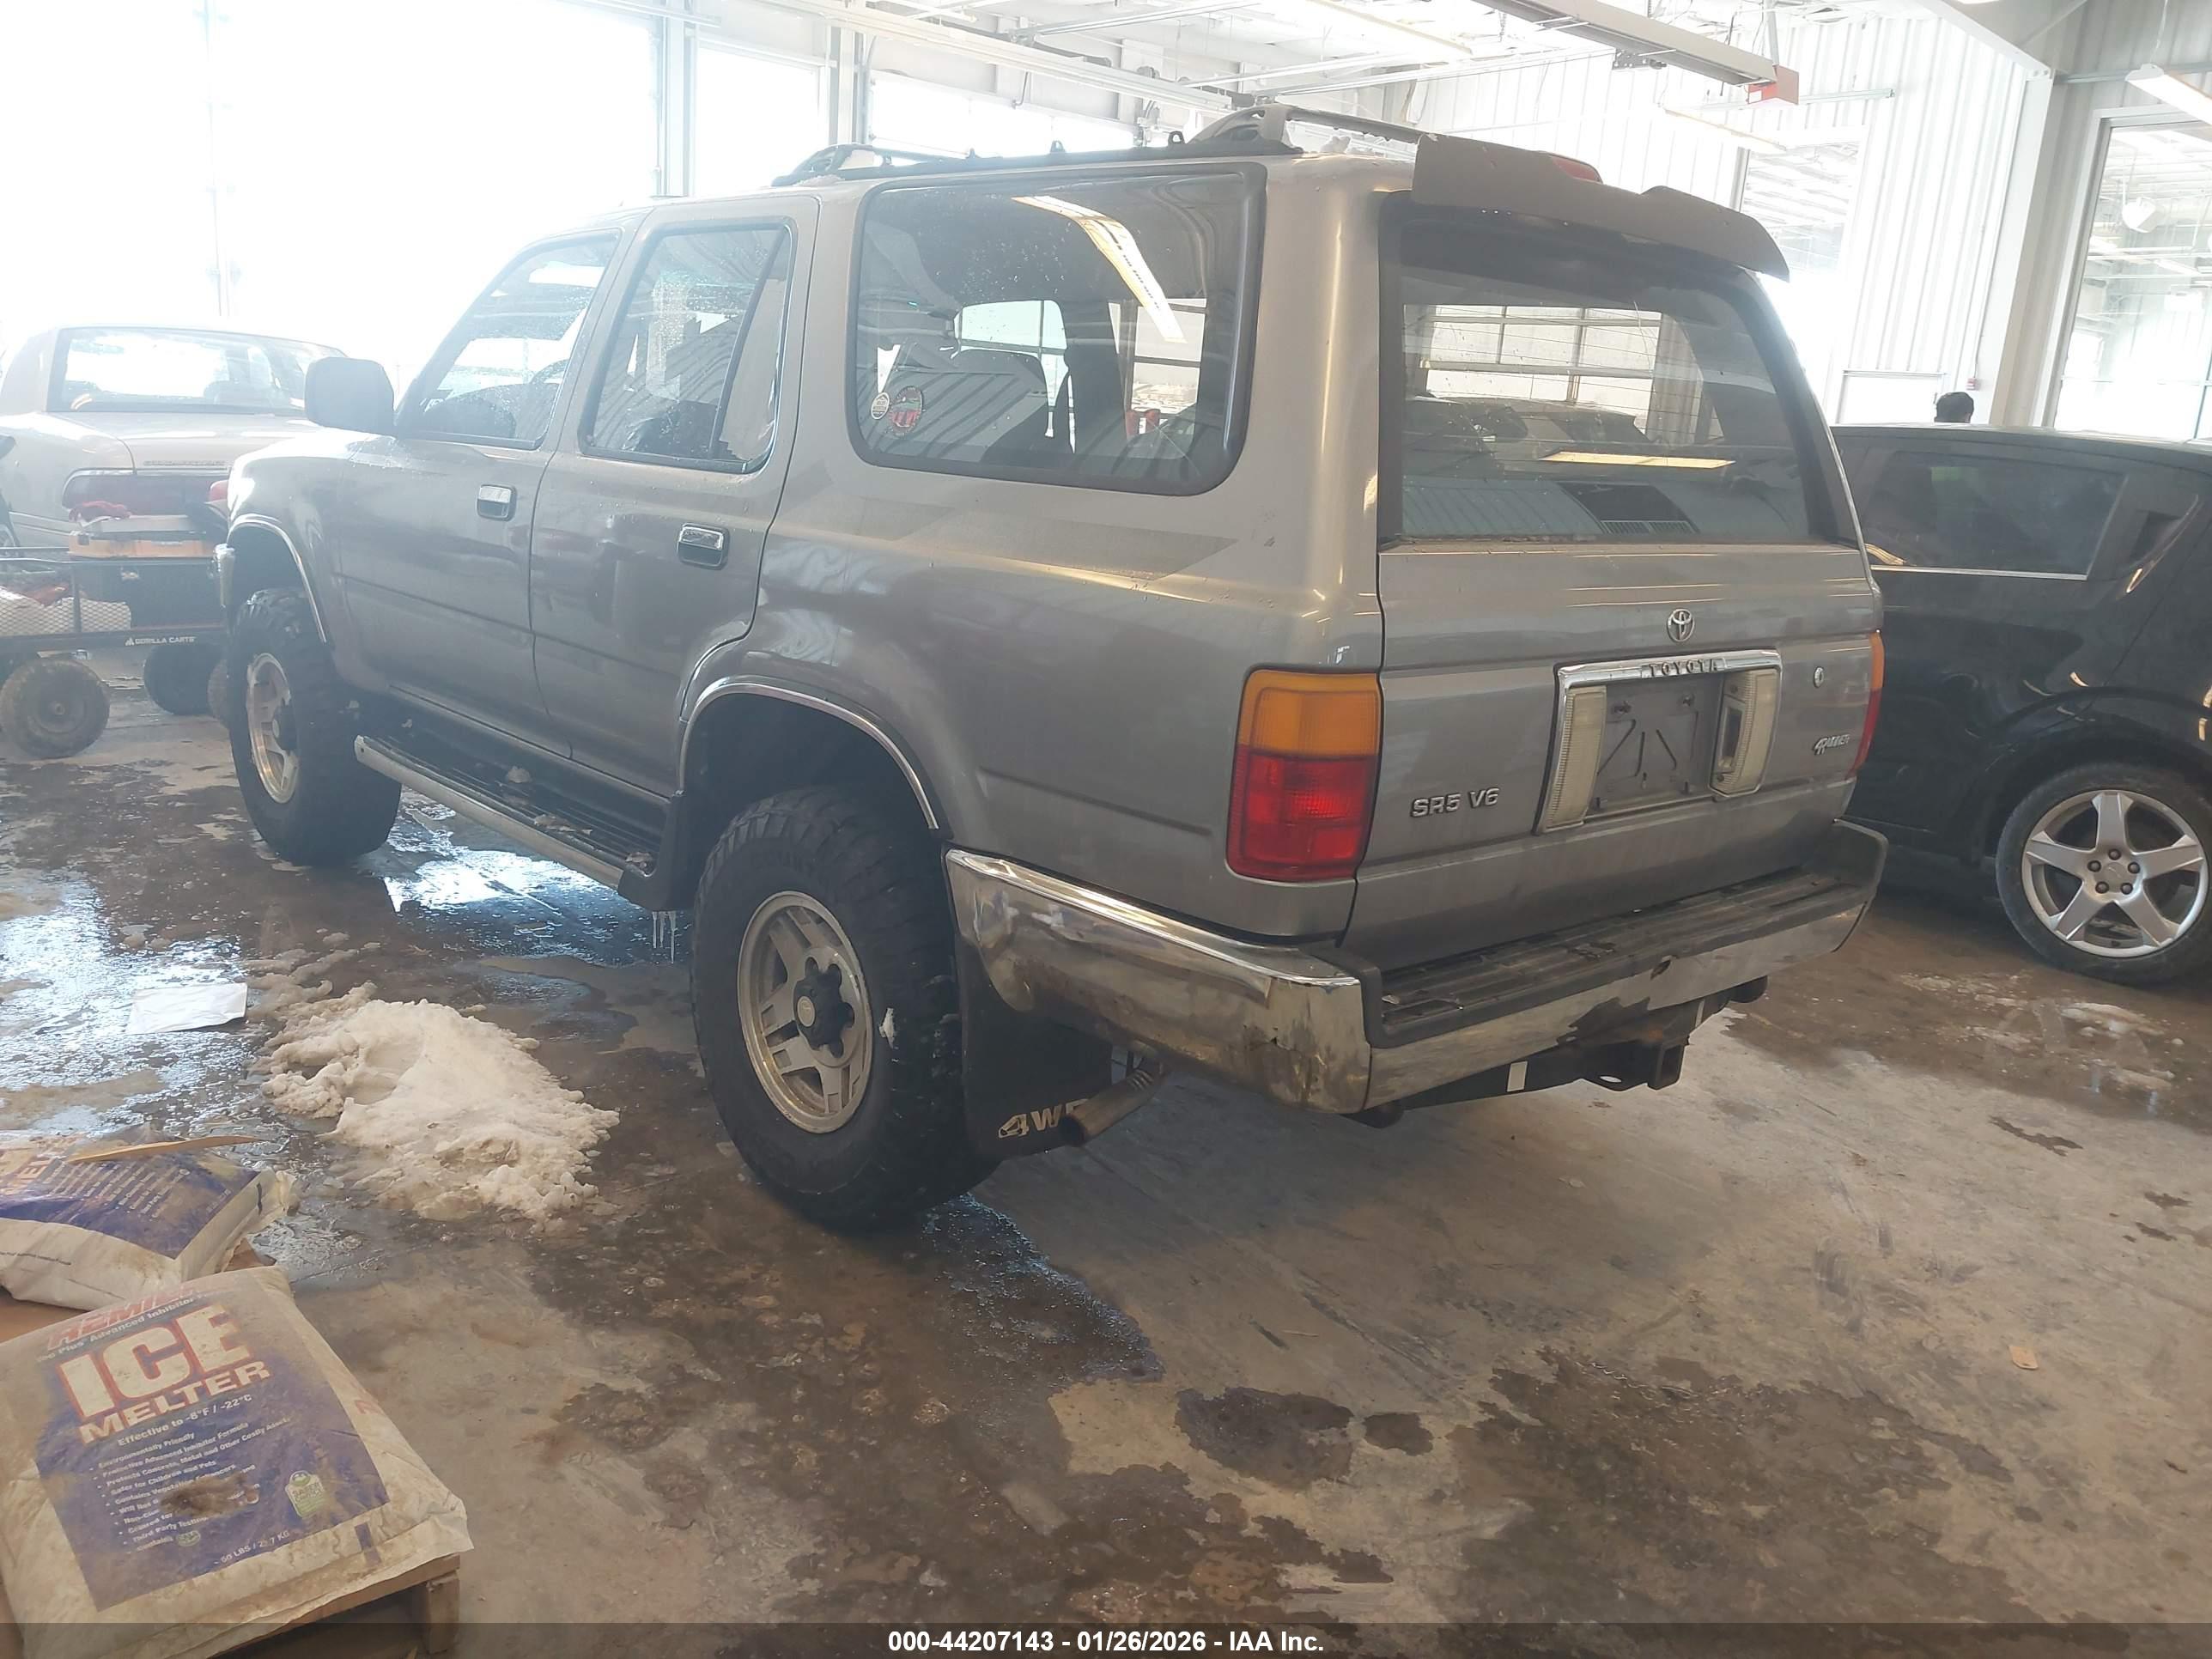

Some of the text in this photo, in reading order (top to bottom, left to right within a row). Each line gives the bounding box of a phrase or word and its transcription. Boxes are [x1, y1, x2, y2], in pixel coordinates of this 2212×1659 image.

[1649, 659, 1718, 677] TOYOTA
[1410, 787, 1499, 817] SR5 V6
[90, 1316, 145, 1342] Advanced
[147, 1297, 194, 1320] Inhibitor
[58, 1303, 251, 1418] ICE
[78, 1360, 271, 1445] MELTER
[117, 1424, 169, 1447] Effective
[172, 1418, 184, 1430] to
[218, 1422, 249, 1438] Formula
[164, 1432, 195, 1447] Friendly
[220, 1438, 240, 1451] Other
[148, 1471, 182, 1485] Children
[234, 1545, 251, 1558] LBS
